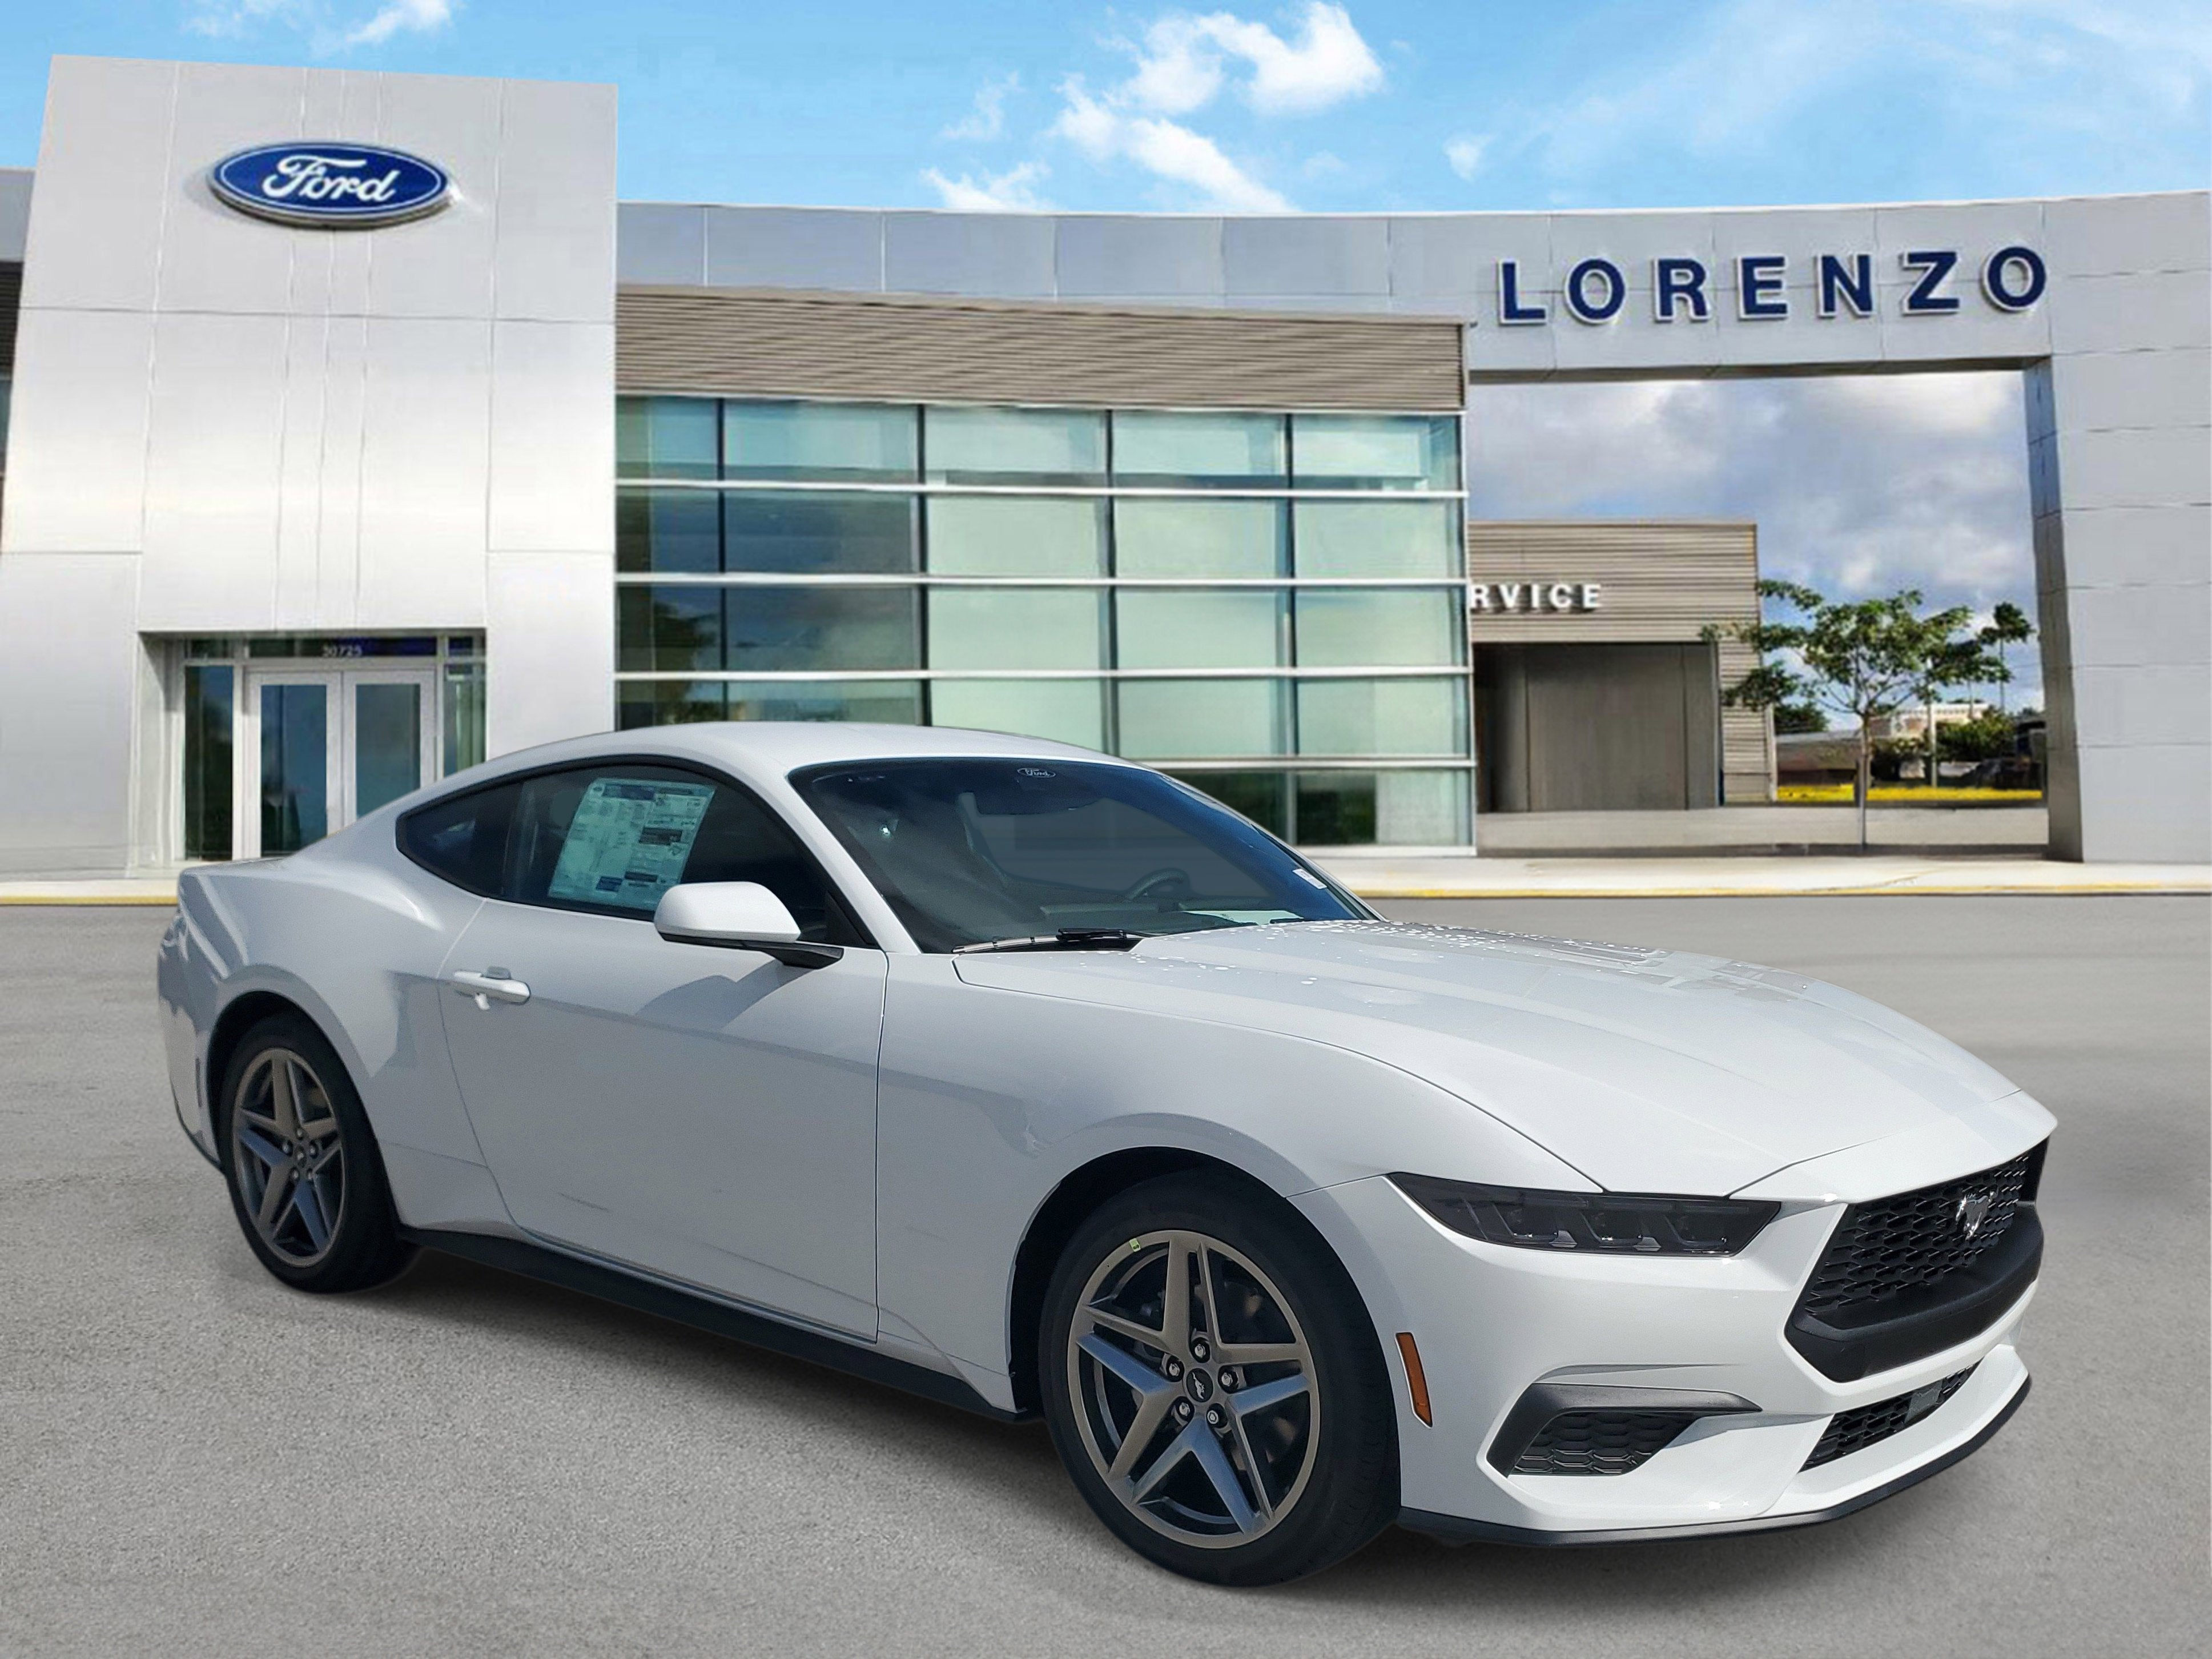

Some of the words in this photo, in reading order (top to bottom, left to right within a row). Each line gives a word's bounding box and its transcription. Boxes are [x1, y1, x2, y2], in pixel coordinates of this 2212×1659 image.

[262, 154, 400, 201] Ford
[1499, 246, 2048, 324] LORENZO
[1470, 583, 1602, 609] RVICE
